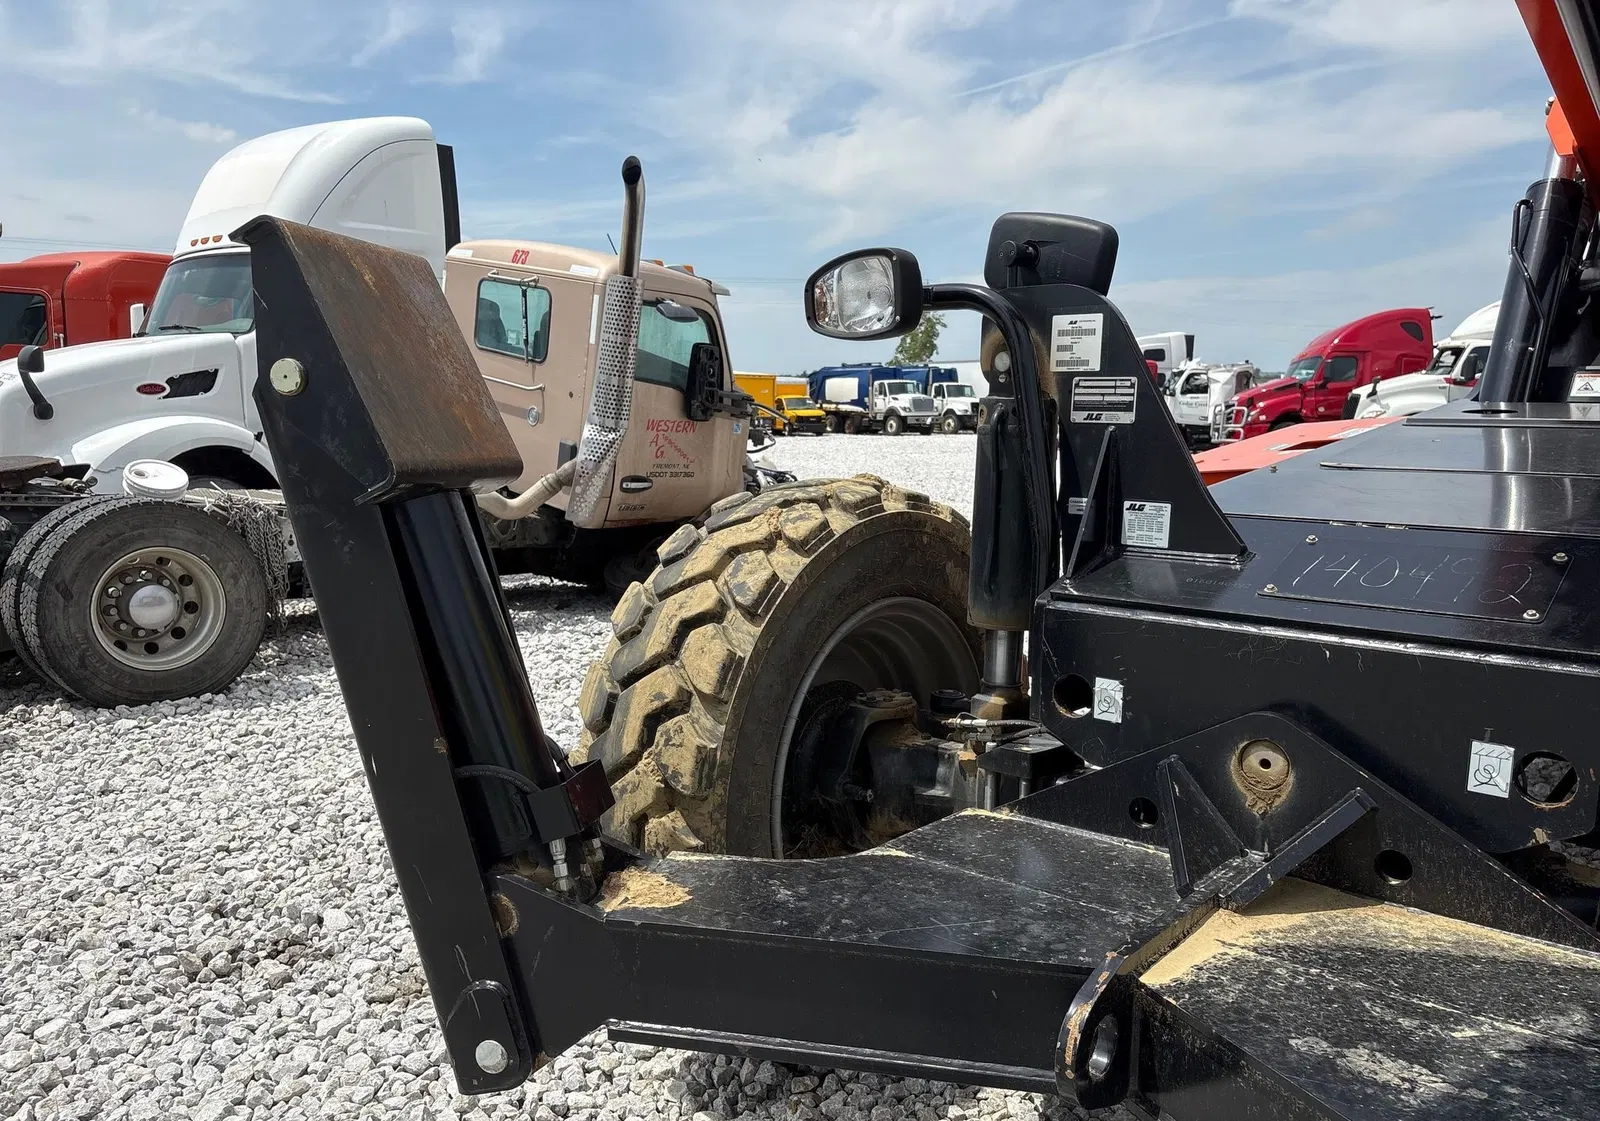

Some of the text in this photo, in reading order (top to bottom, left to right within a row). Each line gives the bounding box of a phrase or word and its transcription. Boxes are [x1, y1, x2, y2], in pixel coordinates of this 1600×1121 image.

[511, 249, 530, 265] 673
[1083, 413, 1104, 421] JLG
[646, 419, 697, 434] WESTERN
[1125, 503, 1146, 512] JLG
[1292, 554, 1532, 605] 140492
